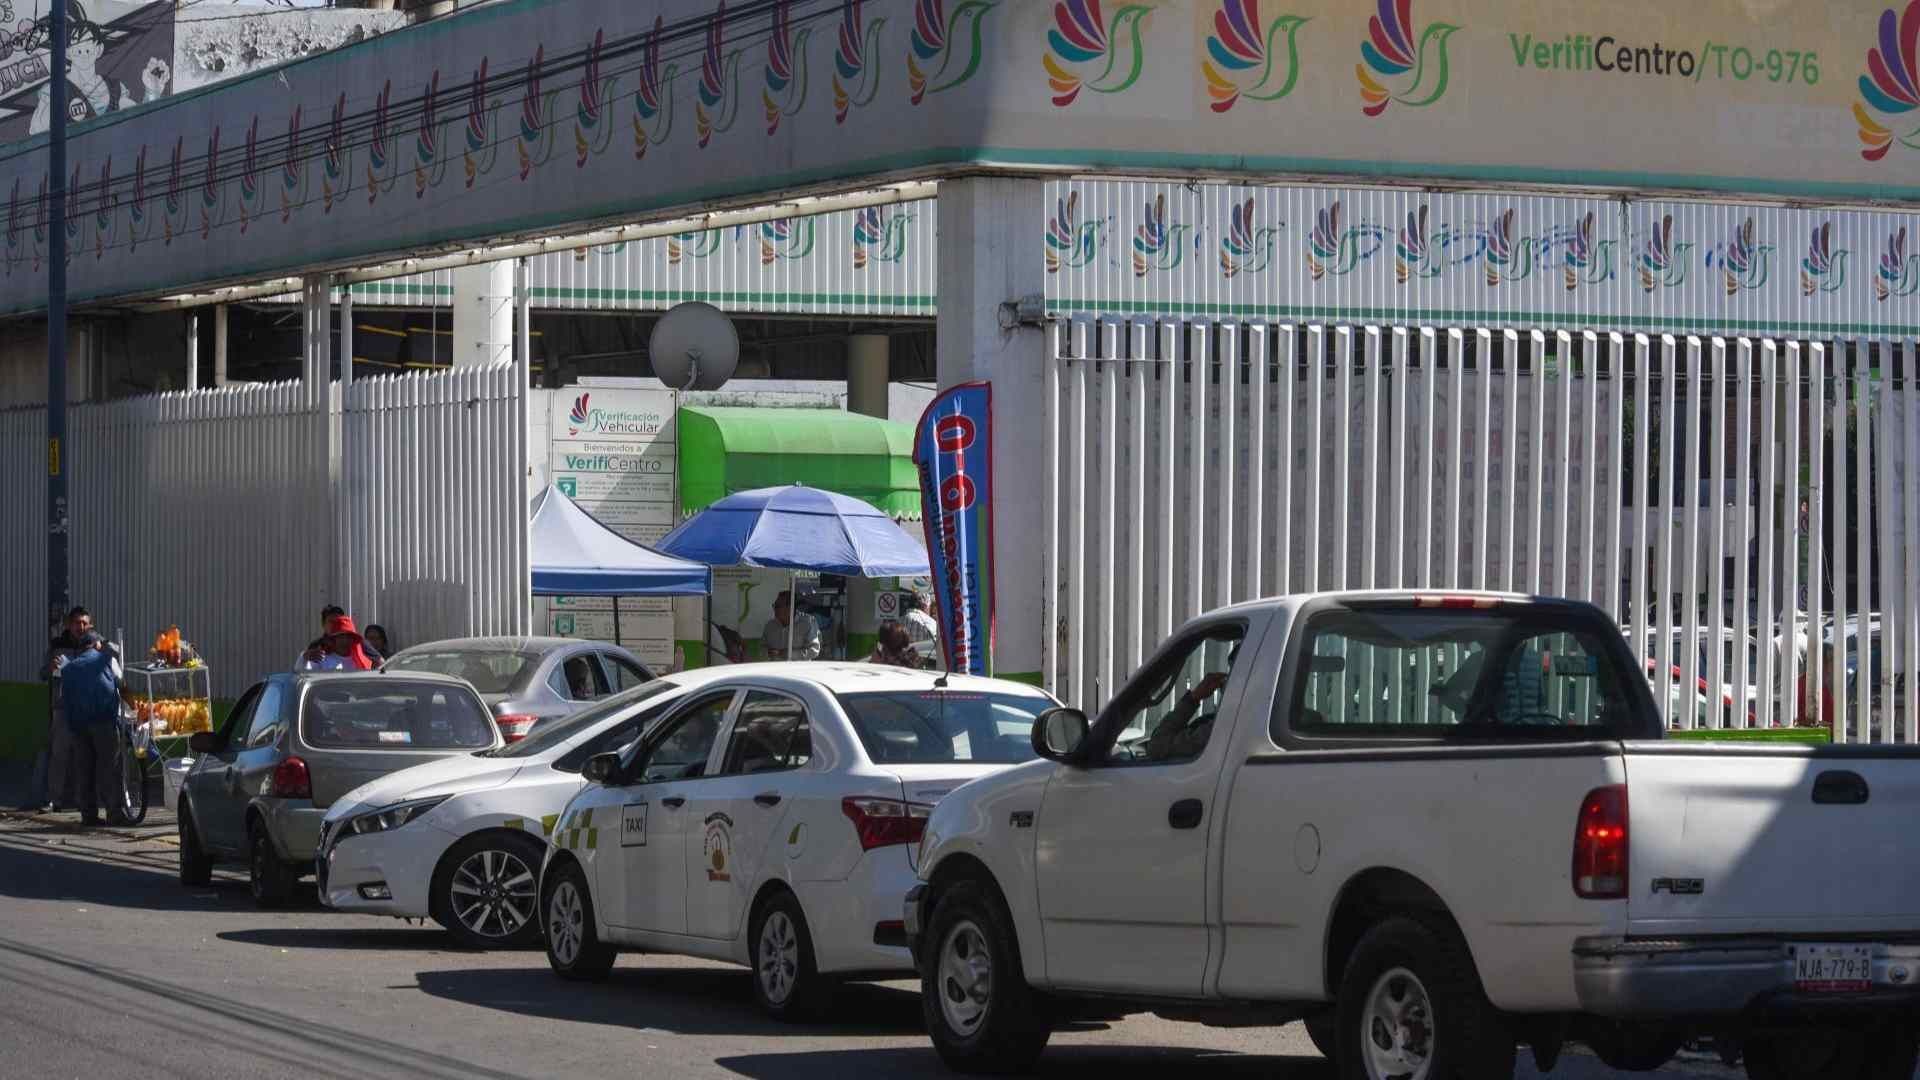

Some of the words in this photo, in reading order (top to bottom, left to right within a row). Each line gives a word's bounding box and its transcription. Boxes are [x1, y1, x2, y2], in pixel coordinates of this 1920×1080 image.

[599, 410, 660, 421] Verificación
[599, 421, 660, 433] Vehicular
[584, 443, 634, 453] Bienvenidos
[566, 455, 662, 471] VerifiCentro
[625, 817, 644, 832] TAXI
[1799, 959, 1869, 978] NJA-779-B
